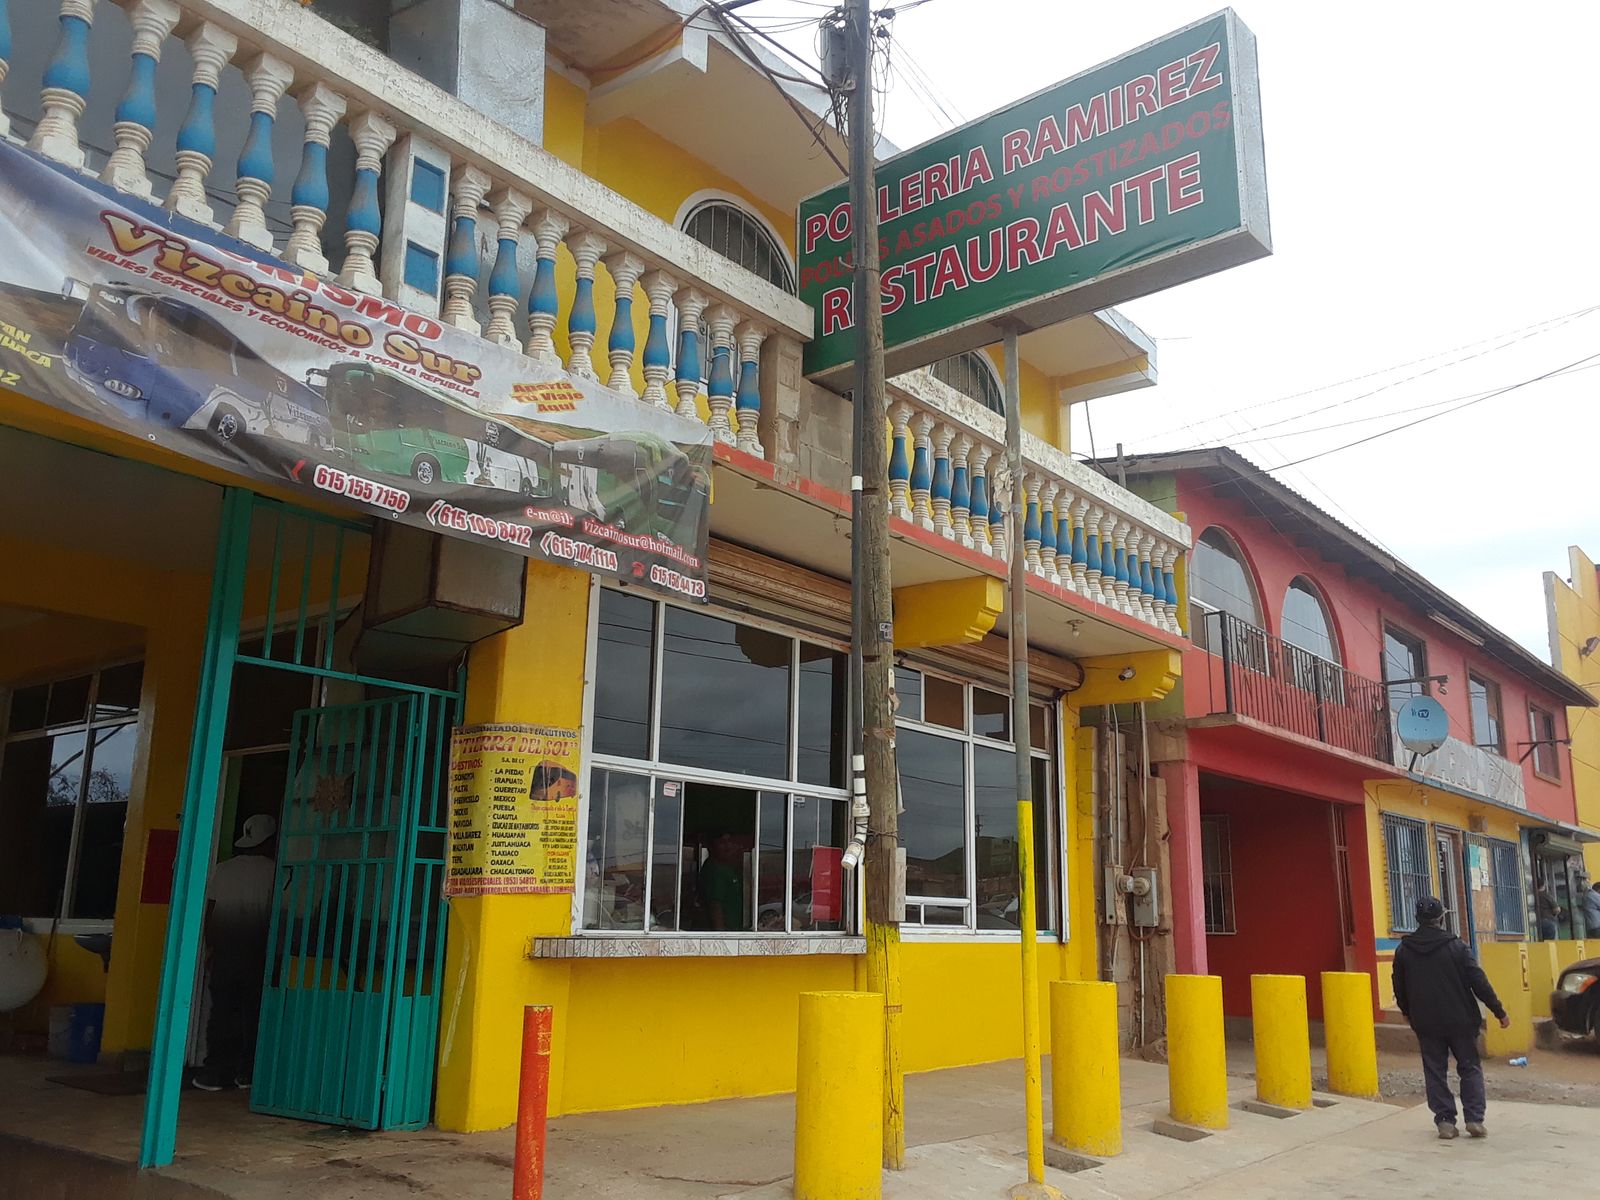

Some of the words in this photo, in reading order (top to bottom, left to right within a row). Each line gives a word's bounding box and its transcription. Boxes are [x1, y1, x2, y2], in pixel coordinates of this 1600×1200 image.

[805, 146, 993, 254] POLERIA
[1003, 43, 1223, 176] RAMIREZ
[895, 195, 1003, 252] ASADOS
[1008, 185, 1027, 210] Y
[1032, 101, 1232, 202] ROSTIZADOS
[823, 151, 1204, 336] RSTAURANTE
[101, 210, 373, 348] Vizcaino
[383, 331, 482, 386] Sur
[87, 246, 148, 275] VIAJES
[150, 271, 245, 312] ESPECIALES
[247, 309, 257, 318] Y
[259, 313, 347, 353] ECONOMICOS
[349, 349, 360, 357] A
[365, 353, 400, 369] TODA
[402, 365, 417, 376] LA
[420, 372, 480, 398] REPUBLICA
[315, 466, 346, 492] 615
[347, 477, 374, 501] 155
[375, 486, 409, 512] 7156
[439, 505, 467, 530] 615
[468, 515, 497, 537] 106
[499, 522, 532, 547] 8412
[526, 508, 573, 526] e-m@il:
[551, 535, 573, 558] 615
[575, 543, 594, 564] 104
[651, 566, 667, 584] 615
[690, 580, 704, 596] 73
[518, 736, 543, 755] DEL
